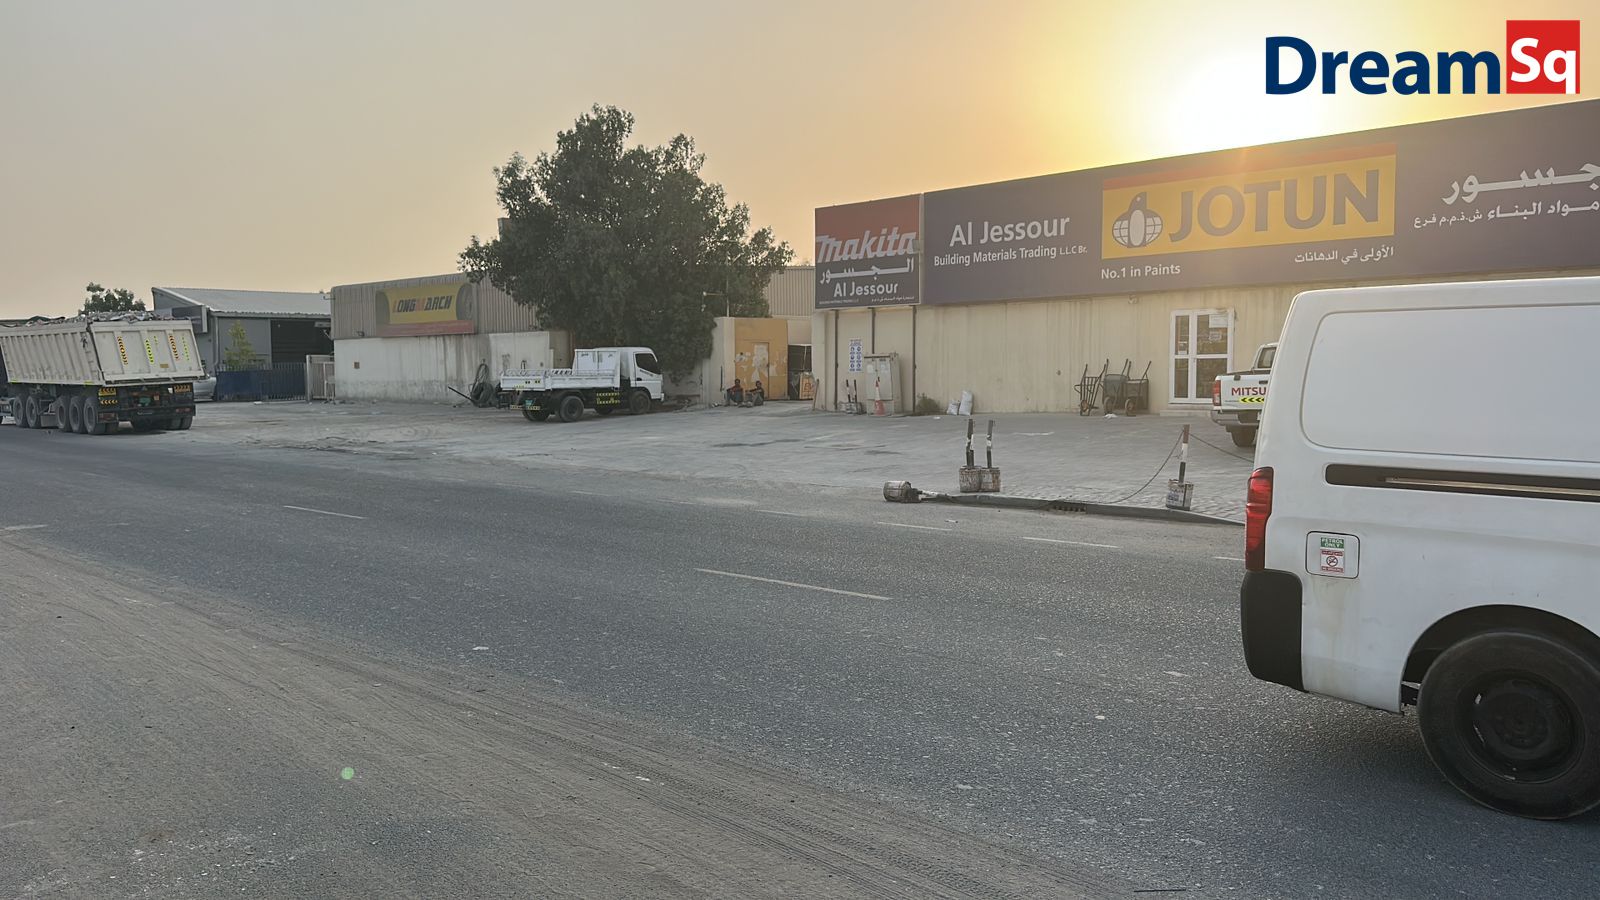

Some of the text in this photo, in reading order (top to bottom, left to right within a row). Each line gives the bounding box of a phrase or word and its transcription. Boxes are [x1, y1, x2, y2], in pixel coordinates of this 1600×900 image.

[1168, 169, 1380, 243] JOTUN
[1487, 201, 1542, 221] البناء
[1414, 214, 1437, 228] فرع
[949, 217, 1070, 247] Al Jessour
[934, 253, 970, 266] Building
[973, 248, 1017, 263] Materials
[1019, 245, 1056, 259] Trading
[1294, 244, 1394, 265] الأولى في الدهانات
[820, 257, 914, 284] الجسور
[1101, 263, 1181, 280] No.1 in Paints
[834, 281, 898, 297] Al Jessour
[1232, 387, 1266, 396] MITSU
